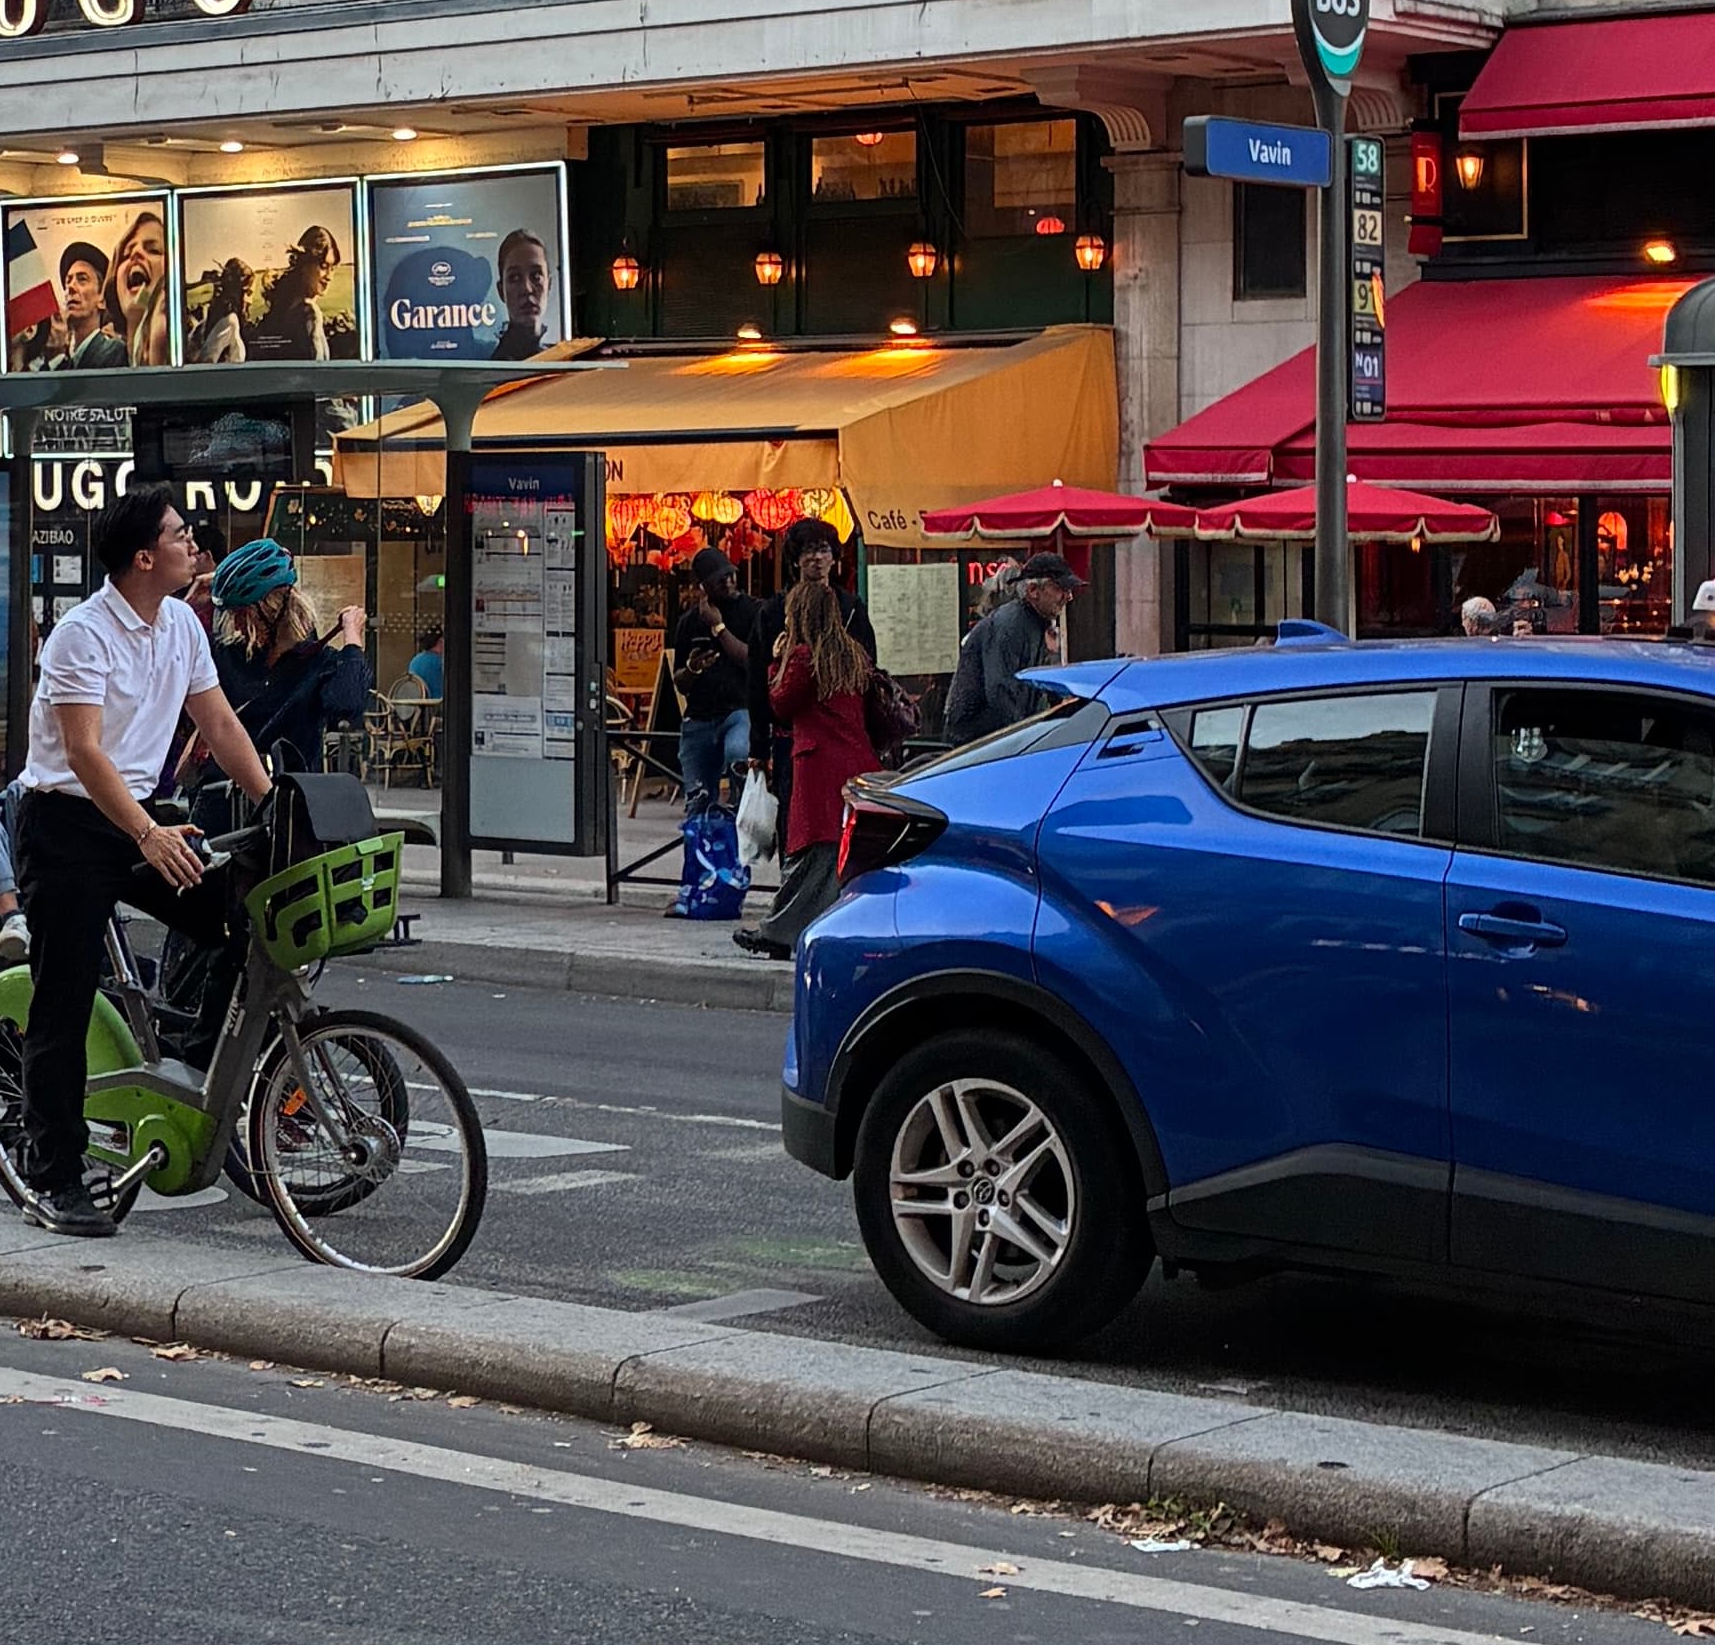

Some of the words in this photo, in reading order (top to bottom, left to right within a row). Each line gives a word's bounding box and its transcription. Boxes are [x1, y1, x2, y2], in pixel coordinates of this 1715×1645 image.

[1248, 138, 1292, 166] Vavin
[1357, 144, 1379, 173] 58
[1357, 213, 1378, 241] 82
[1358, 283, 1375, 310] 9
[390, 298, 496, 330] Garance
[1355, 352, 1379, 378] N01
[508, 477, 540, 490] Vavin
[867, 510, 908, 531] Café
